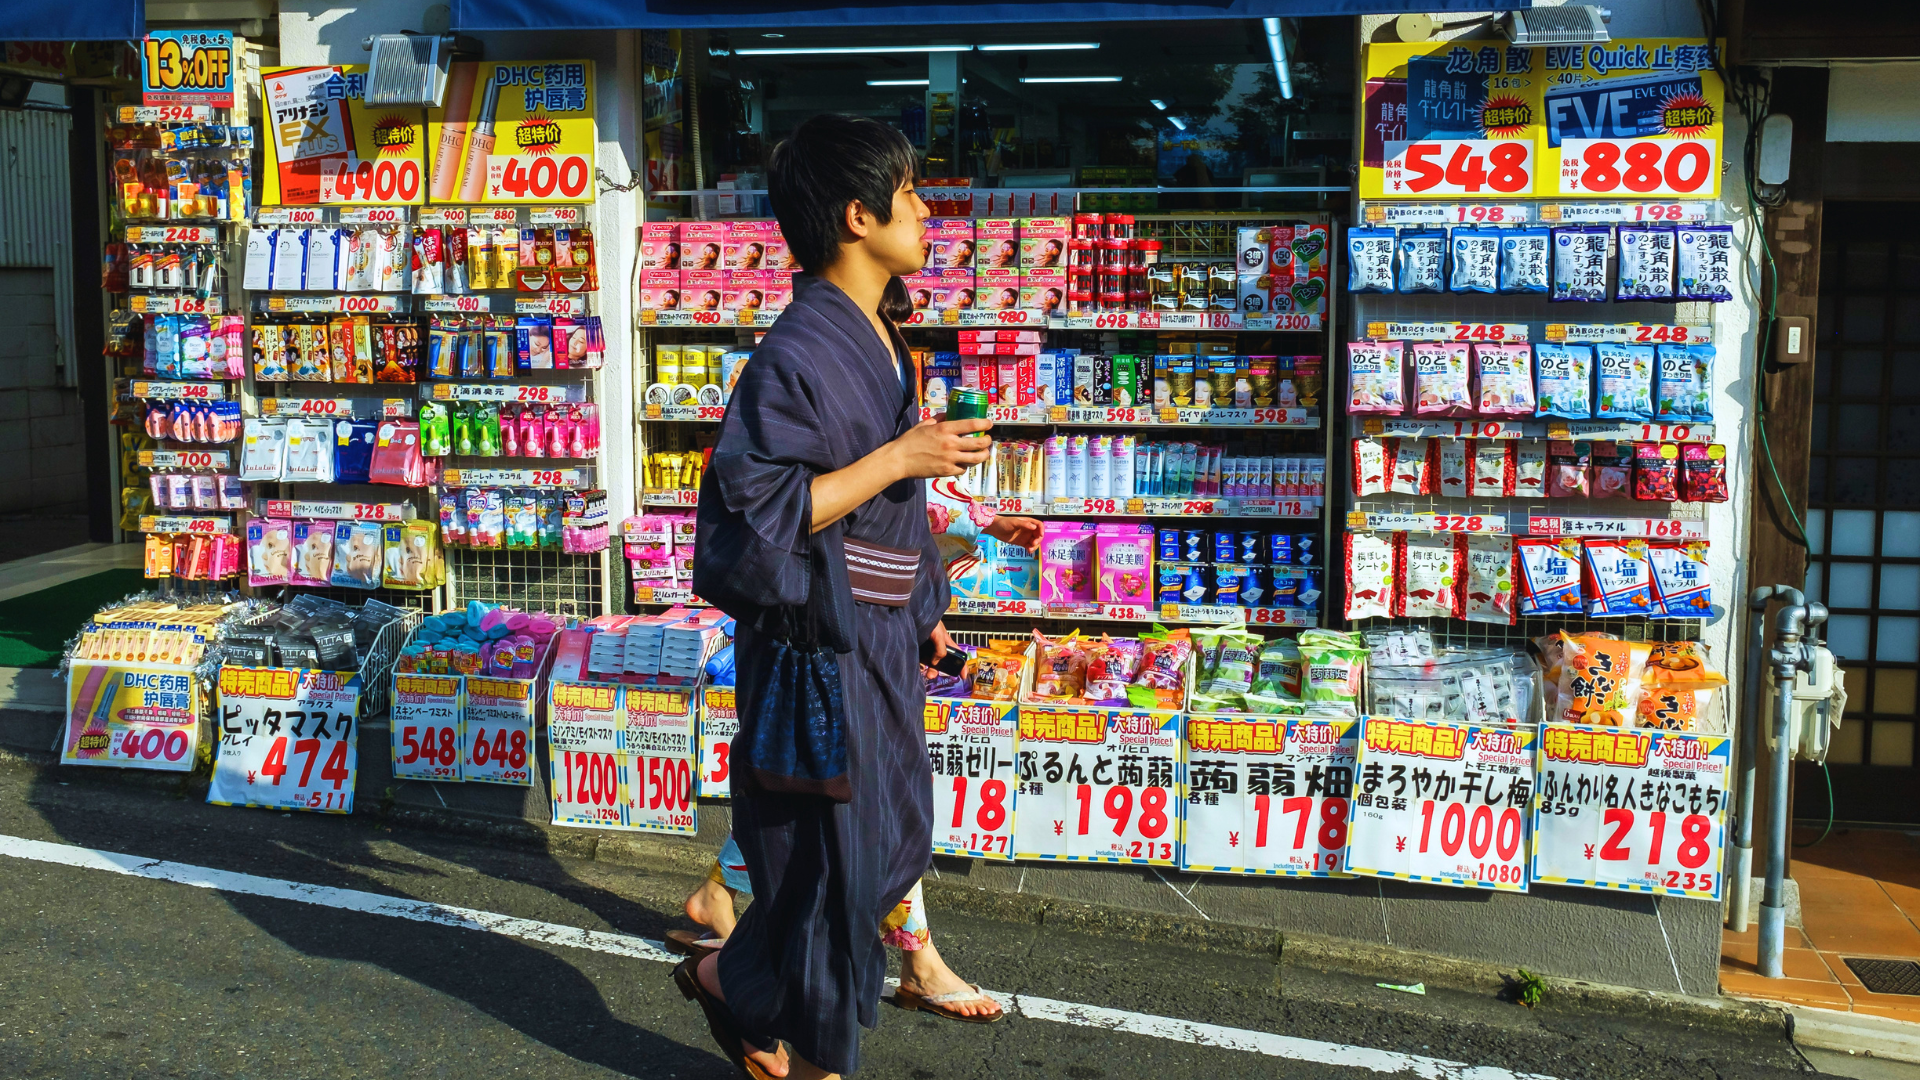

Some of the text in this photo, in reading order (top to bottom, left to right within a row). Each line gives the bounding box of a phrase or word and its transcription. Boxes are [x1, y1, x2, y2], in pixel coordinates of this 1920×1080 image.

[146, 39, 230, 88] 13%OFF
[1446, 46, 1532, 74] 龙角散
[1545, 46, 1584, 69] EVE
[1588, 44, 1648, 74] Quick
[1424, 79, 1467, 100] 龍角散
[1634, 82, 1698, 99] EVE QUICK
[525, 87, 586, 111] 护唇膏
[160, 107, 194, 120] 594
[277, 102, 328, 124] アリナミン
[1484, 107, 1530, 126] 超特价
[1548, 89, 1637, 145] EVE
[1665, 108, 1712, 127] 超特价
[279, 116, 330, 147] EX
[517, 124, 560, 146] 超特价
[293, 134, 339, 159] PLUS
[440, 133, 462, 147] DHC
[471, 136, 492, 150] DHC
[1386, 160, 1402, 168] 免税
[1405, 142, 1529, 193] 548
[1562, 159, 1579, 167] 免税
[1581, 142, 1711, 193] 880
[502, 156, 588, 198] 400
[1386, 170, 1402, 178] 价格
[1562, 169, 1578, 177] 价格
[335, 160, 420, 201] 4900
[288, 211, 314, 222] 1800
[368, 210, 395, 221] 800
[444, 211, 464, 220] 900
[494, 210, 515, 220] 880
[555, 210, 576, 219] 980
[1458, 207, 1504, 222] 198
[1634, 205, 1683, 221] 198
[165, 228, 200, 242] 248
[1275, 251, 1291, 259] 150
[1650, 234, 1672, 294] 龍角散の
[174, 299, 205, 312] 168
[339, 298, 379, 311] 1000
[457, 298, 479, 311] 980
[548, 300, 571, 313] 450
[693, 312, 720, 324] 980
[998, 311, 1027, 324] 980
[1096, 314, 1128, 328] 698
[1200, 314, 1230, 328] 1180
[1275, 315, 1310, 329] 2300
[1455, 325, 1505, 340] 248
[1636, 326, 1688, 342] 248
[182, 386, 208, 397] 348
[518, 388, 549, 401] 298
[301, 400, 337, 414] 400
[385, 407, 397, 415] 300
[698, 407, 725, 419] 398
[995, 407, 1019, 421] 598
[1106, 408, 1135, 422] 598
[1254, 409, 1288, 423] 598
[1454, 422, 1500, 437] 110
[1641, 425, 1690, 440] 110
[177, 453, 212, 466] 700
[532, 471, 562, 485] 298
[678, 491, 698, 504] 198
[354, 505, 385, 519] 328
[999, 498, 1022, 512] 598
[1083, 499, 1116, 513] 598
[1183, 501, 1214, 514] 298
[1277, 502, 1301, 515] 178
[189, 520, 215, 532] 498
[1434, 516, 1483, 531] 328
[1540, 518, 1682, 536] 免税 塩キャラメル 168
[1048, 549, 1086, 561] 休足美麗
[1105, 552, 1144, 566] 休足美麗
[1545, 558, 1569, 576] 塩
[1674, 560, 1698, 579] 塩
[958, 600, 1027, 614] 休足時間 548
[1109, 608, 1134, 619] 438
[1245, 609, 1286, 623] 188
[1310, 668, 1349, 681] 蒟蒻畑
[144, 692, 190, 709] 护唇膏
[309, 691, 333, 700] Special
[298, 700, 333, 709] アラクス
[395, 706, 453, 718] スキンベープミスト
[223, 704, 353, 742] ピッタマスク
[962, 725, 989, 736] Special
[121, 729, 188, 761] 400
[222, 734, 253, 746] グレイ
[402, 726, 456, 766] 548
[949, 735, 991, 744] オリヒロ
[1120, 735, 1147, 744] Special
[473, 727, 527, 769] 648
[1107, 744, 1150, 754] オリヒロ
[1299, 745, 1328, 754] Special
[261, 737, 349, 790] 474
[1286, 755, 1356, 763] マンナンライフ
[1478, 753, 1508, 763] Special
[1663, 759, 1695, 770] Special
[1020, 751, 1173, 788] ぷるんと蒟蒻
[1465, 761, 1521, 774] トモエ物産
[1648, 768, 1697, 781] 越後製菓
[565, 751, 617, 806] 1200
[637, 756, 690, 812] 1500
[1190, 760, 1353, 798] 蒟蒻畑
[1363, 761, 1532, 809] まろやか干し梅
[1188, 792, 1220, 806] 各種
[1544, 770, 1721, 816] ふんわり名人きなこもち
[1357, 793, 1408, 811] 個包装
[1076, 785, 1168, 839] 198
[1363, 812, 1384, 820] 160g
[1540, 801, 1580, 818] 85g
[1254, 795, 1348, 851] 178
[1419, 800, 1521, 862] 1000
[1599, 808, 1712, 869] 218
